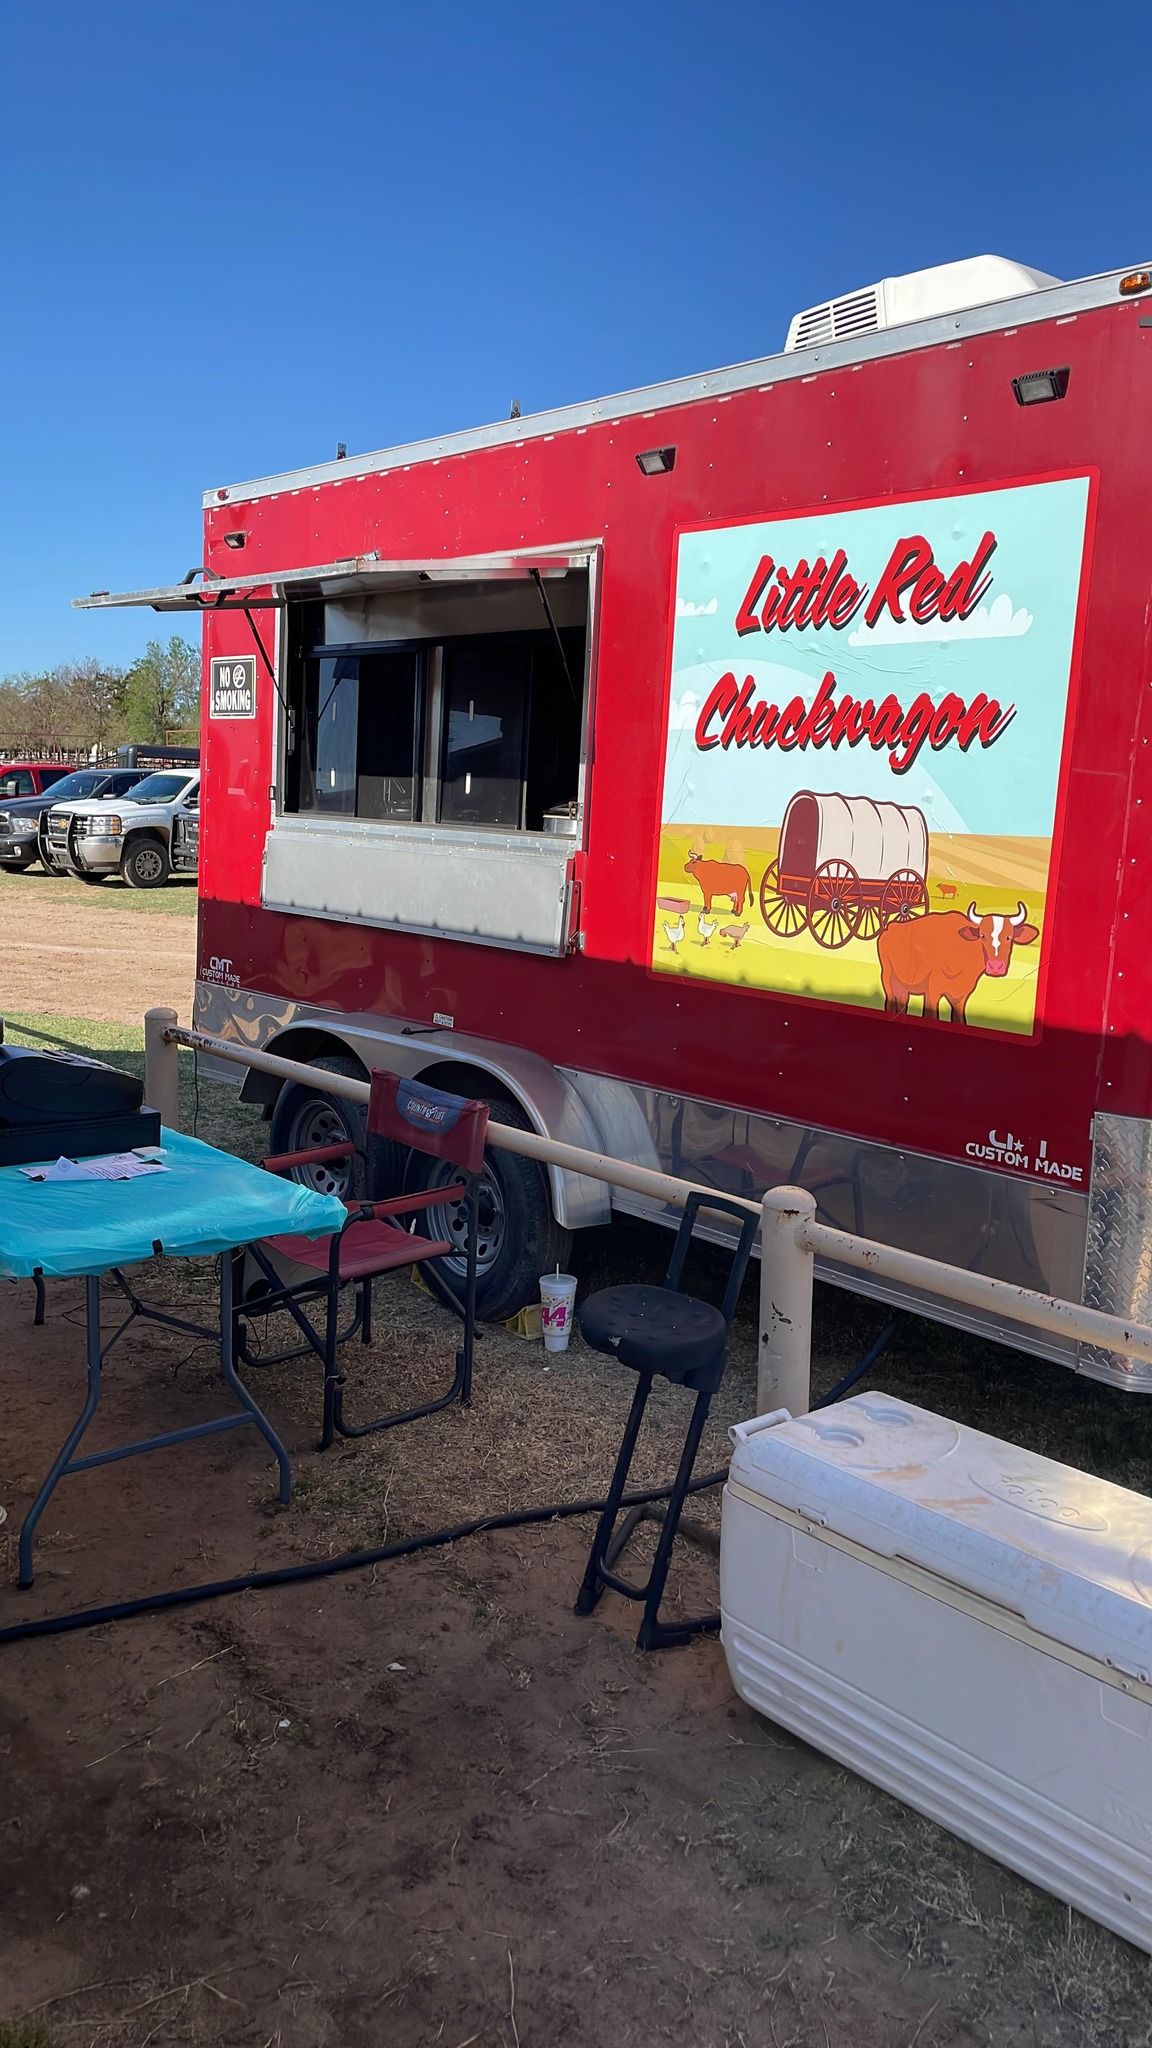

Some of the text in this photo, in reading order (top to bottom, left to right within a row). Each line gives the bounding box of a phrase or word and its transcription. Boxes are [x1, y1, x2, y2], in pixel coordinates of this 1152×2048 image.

[735, 531, 999, 637] Little Red
[219, 666, 231, 688] NO
[215, 689, 251, 711] SMOKING
[695, 671, 1017, 775] Chuckwagon
[202, 968, 224, 980] CUSTOM
[224, 973, 241, 983] MADE
[965, 1142, 1029, 1169] CUSTOM
[1034, 1158, 1083, 1182] MADE
